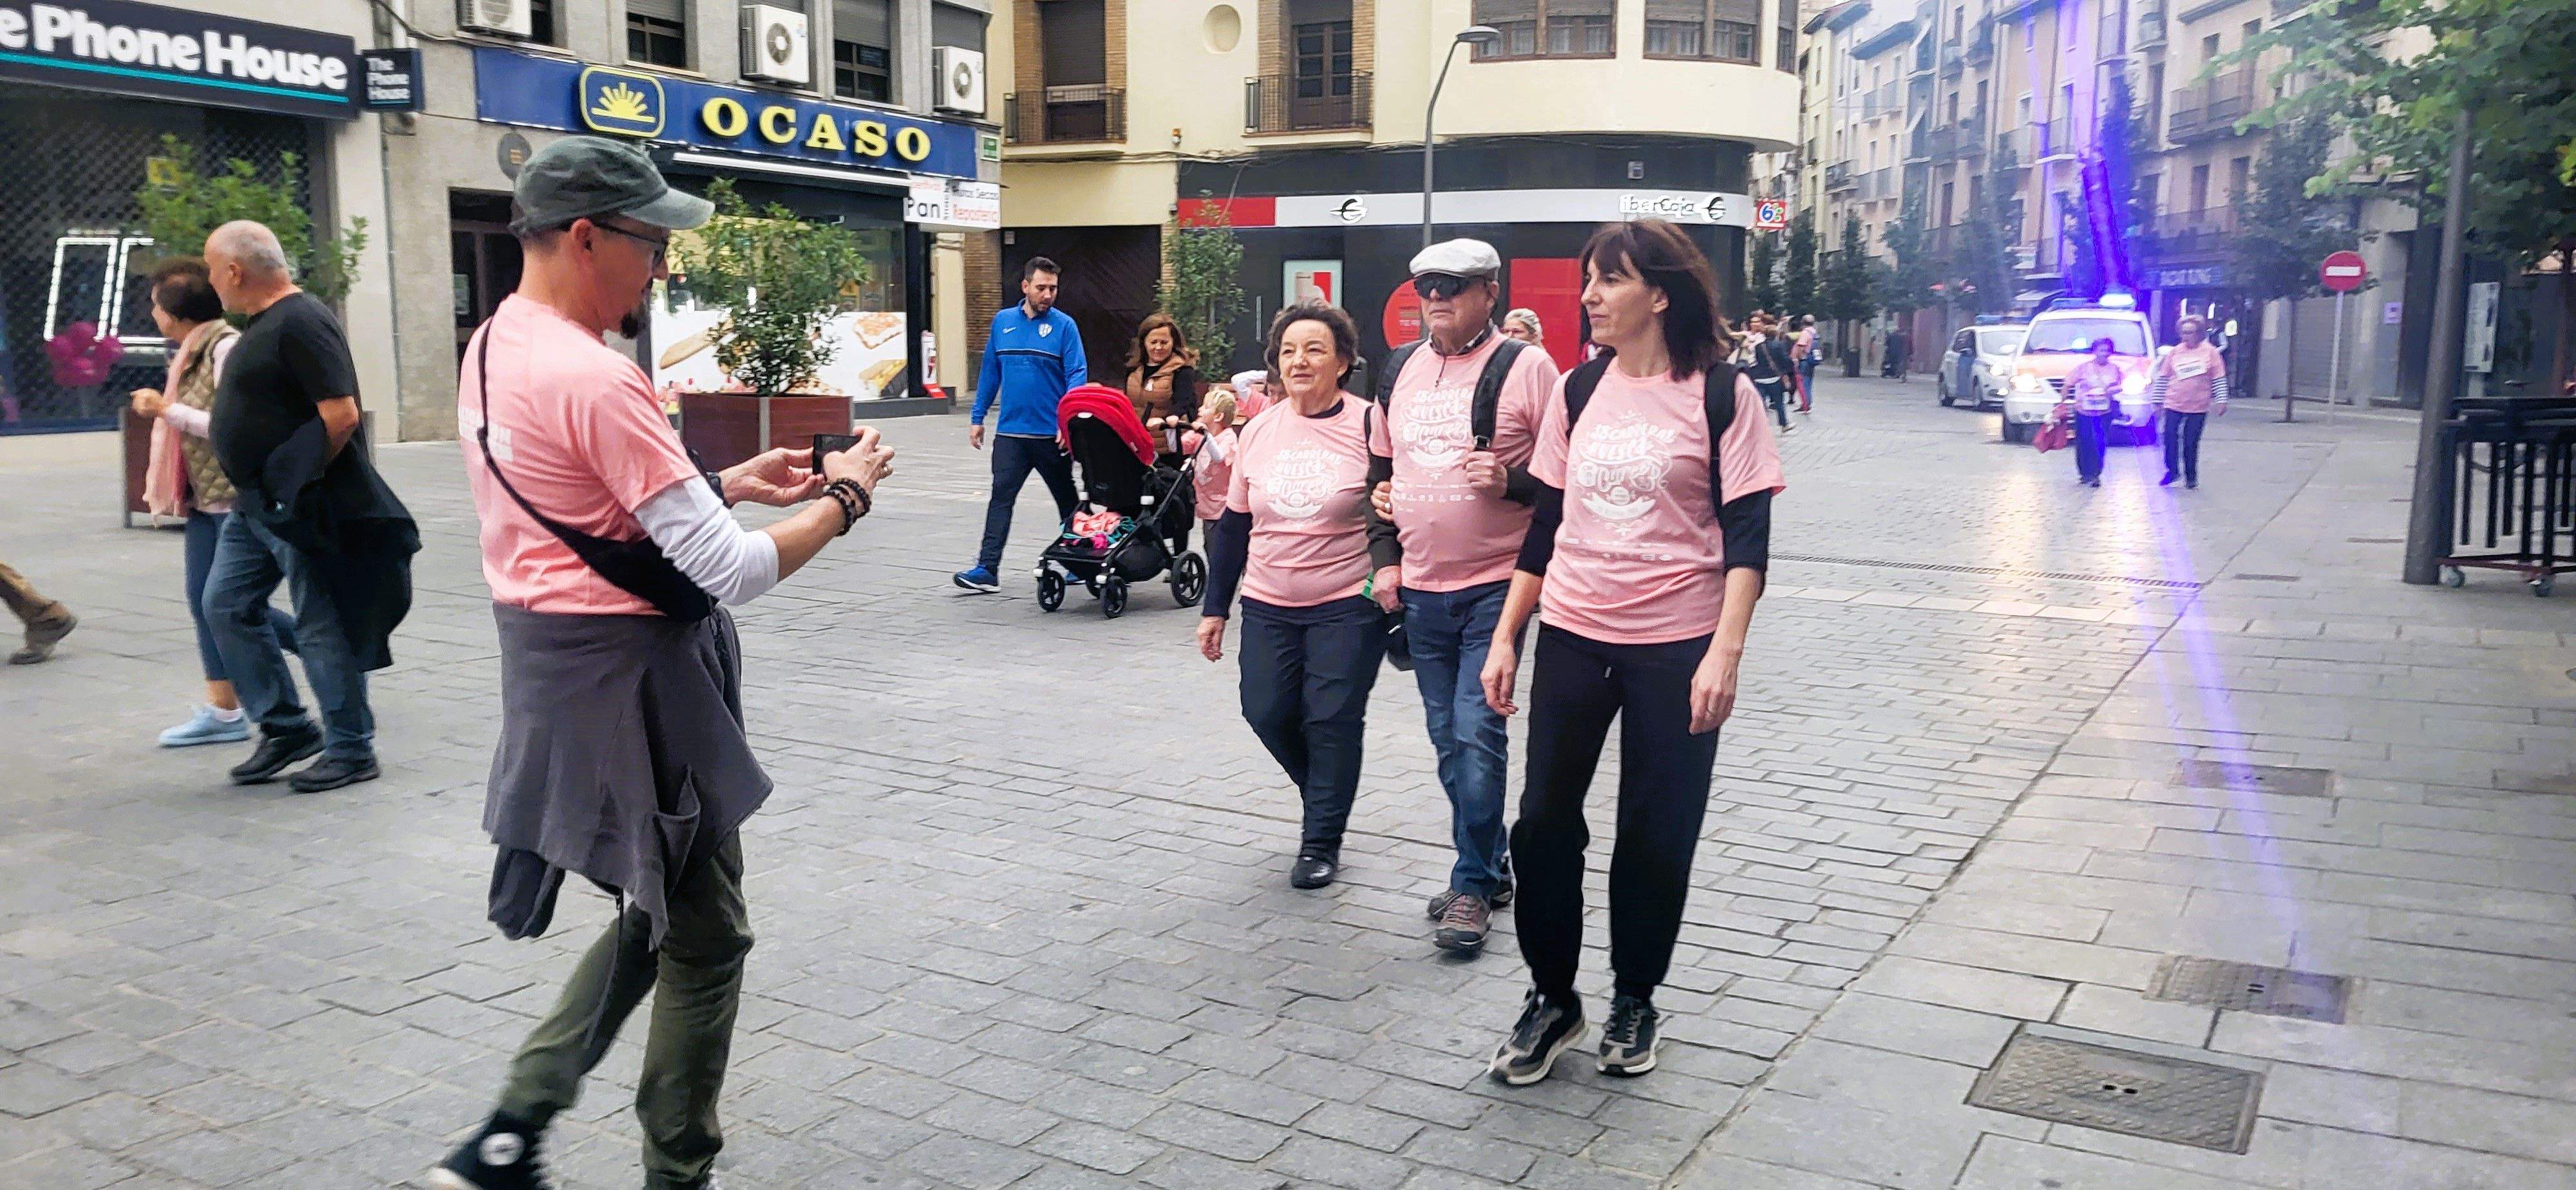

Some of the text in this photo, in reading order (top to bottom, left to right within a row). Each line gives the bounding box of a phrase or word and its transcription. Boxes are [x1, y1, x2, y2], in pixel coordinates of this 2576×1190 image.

[31, 4, 201, 71] Phone
[203, 30, 348, 90] House
[366, 57, 394, 71] The
[366, 72, 410, 85] Phone
[367, 87, 410, 100] House
[701, 97, 931, 162] OCASO
[904, 196, 940, 218] Pan
